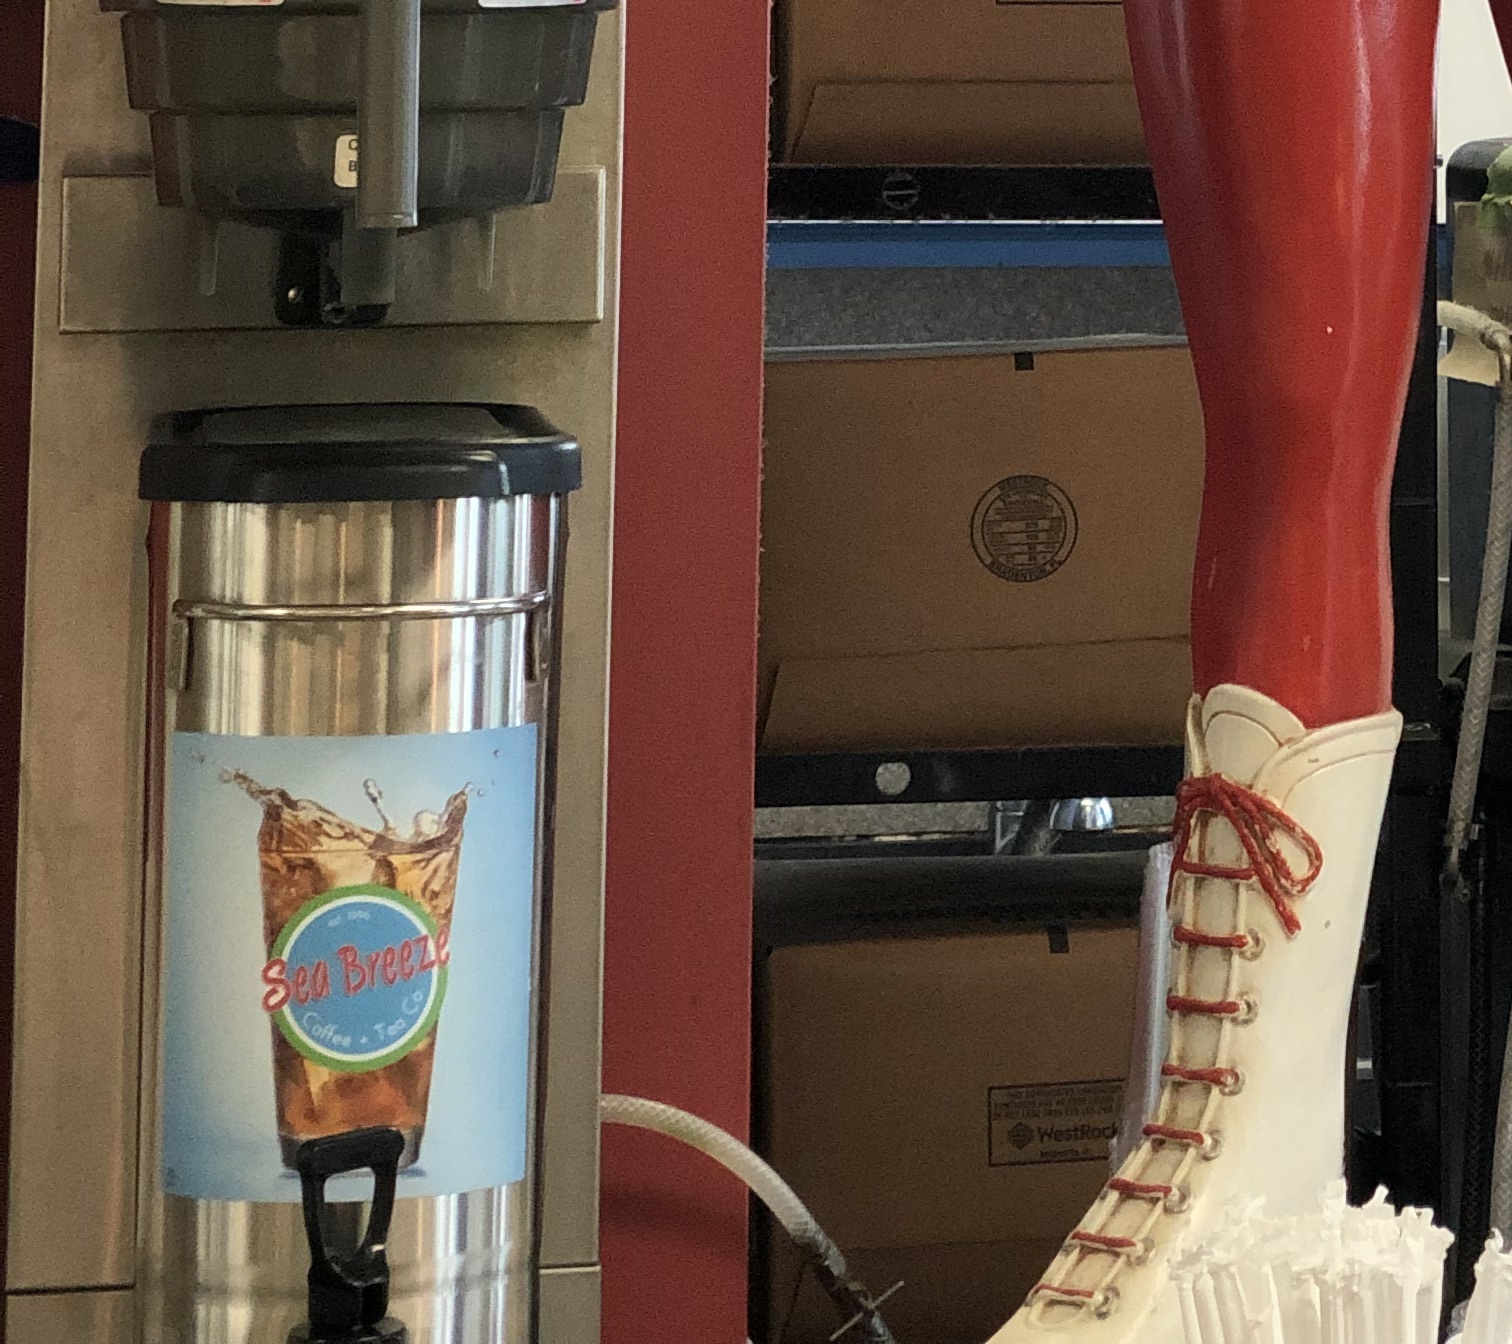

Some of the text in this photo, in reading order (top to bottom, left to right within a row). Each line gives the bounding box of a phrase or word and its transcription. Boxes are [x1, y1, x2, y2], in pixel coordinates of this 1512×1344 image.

[262, 925, 450, 1011] Sea Breeze
[303, 1012, 352, 1046] Coffee
